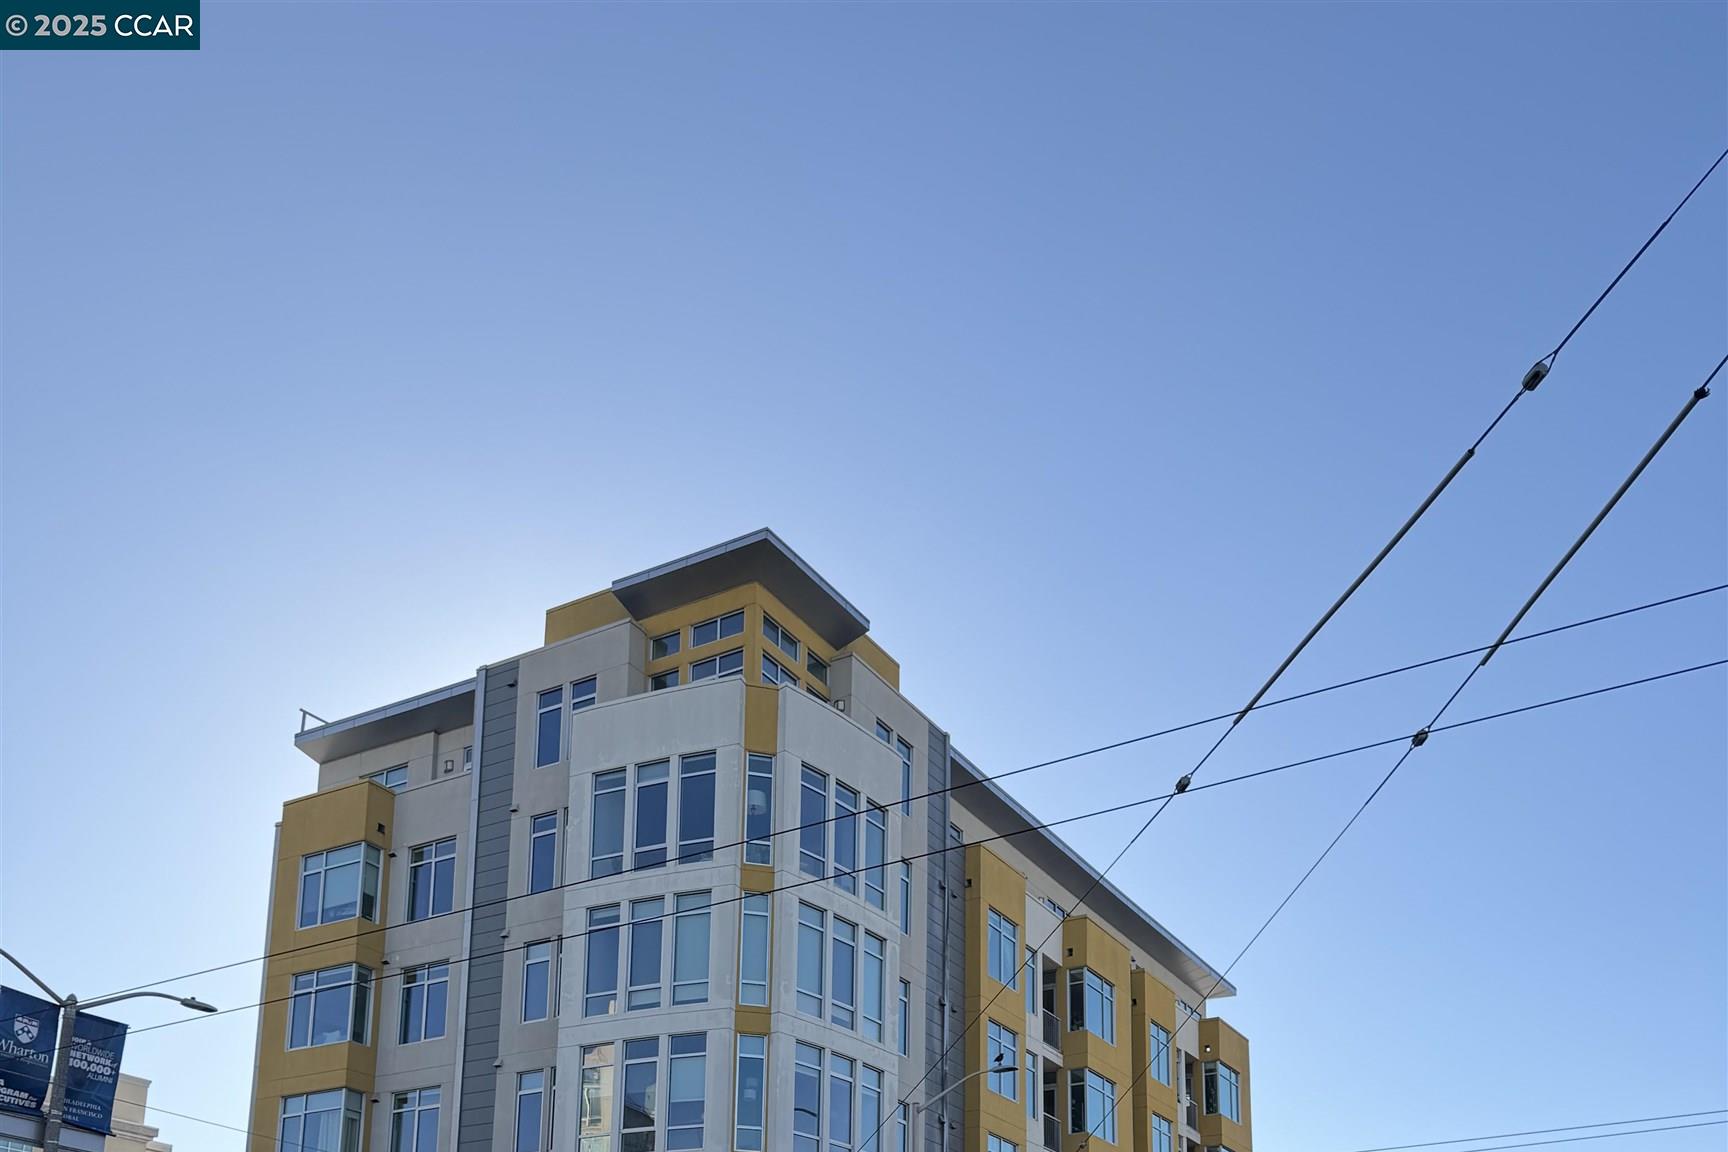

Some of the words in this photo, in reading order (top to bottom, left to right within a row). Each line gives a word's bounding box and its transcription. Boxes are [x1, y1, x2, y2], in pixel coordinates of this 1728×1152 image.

[70, 1049, 112, 1067] NETWORK
[68, 1057, 116, 1076] 100,000+
[87, 1072, 114, 1084] ALUMNI
[0, 1086, 29, 1100] GRAM
[63, 1098, 102, 1111] HILADELPHIA
